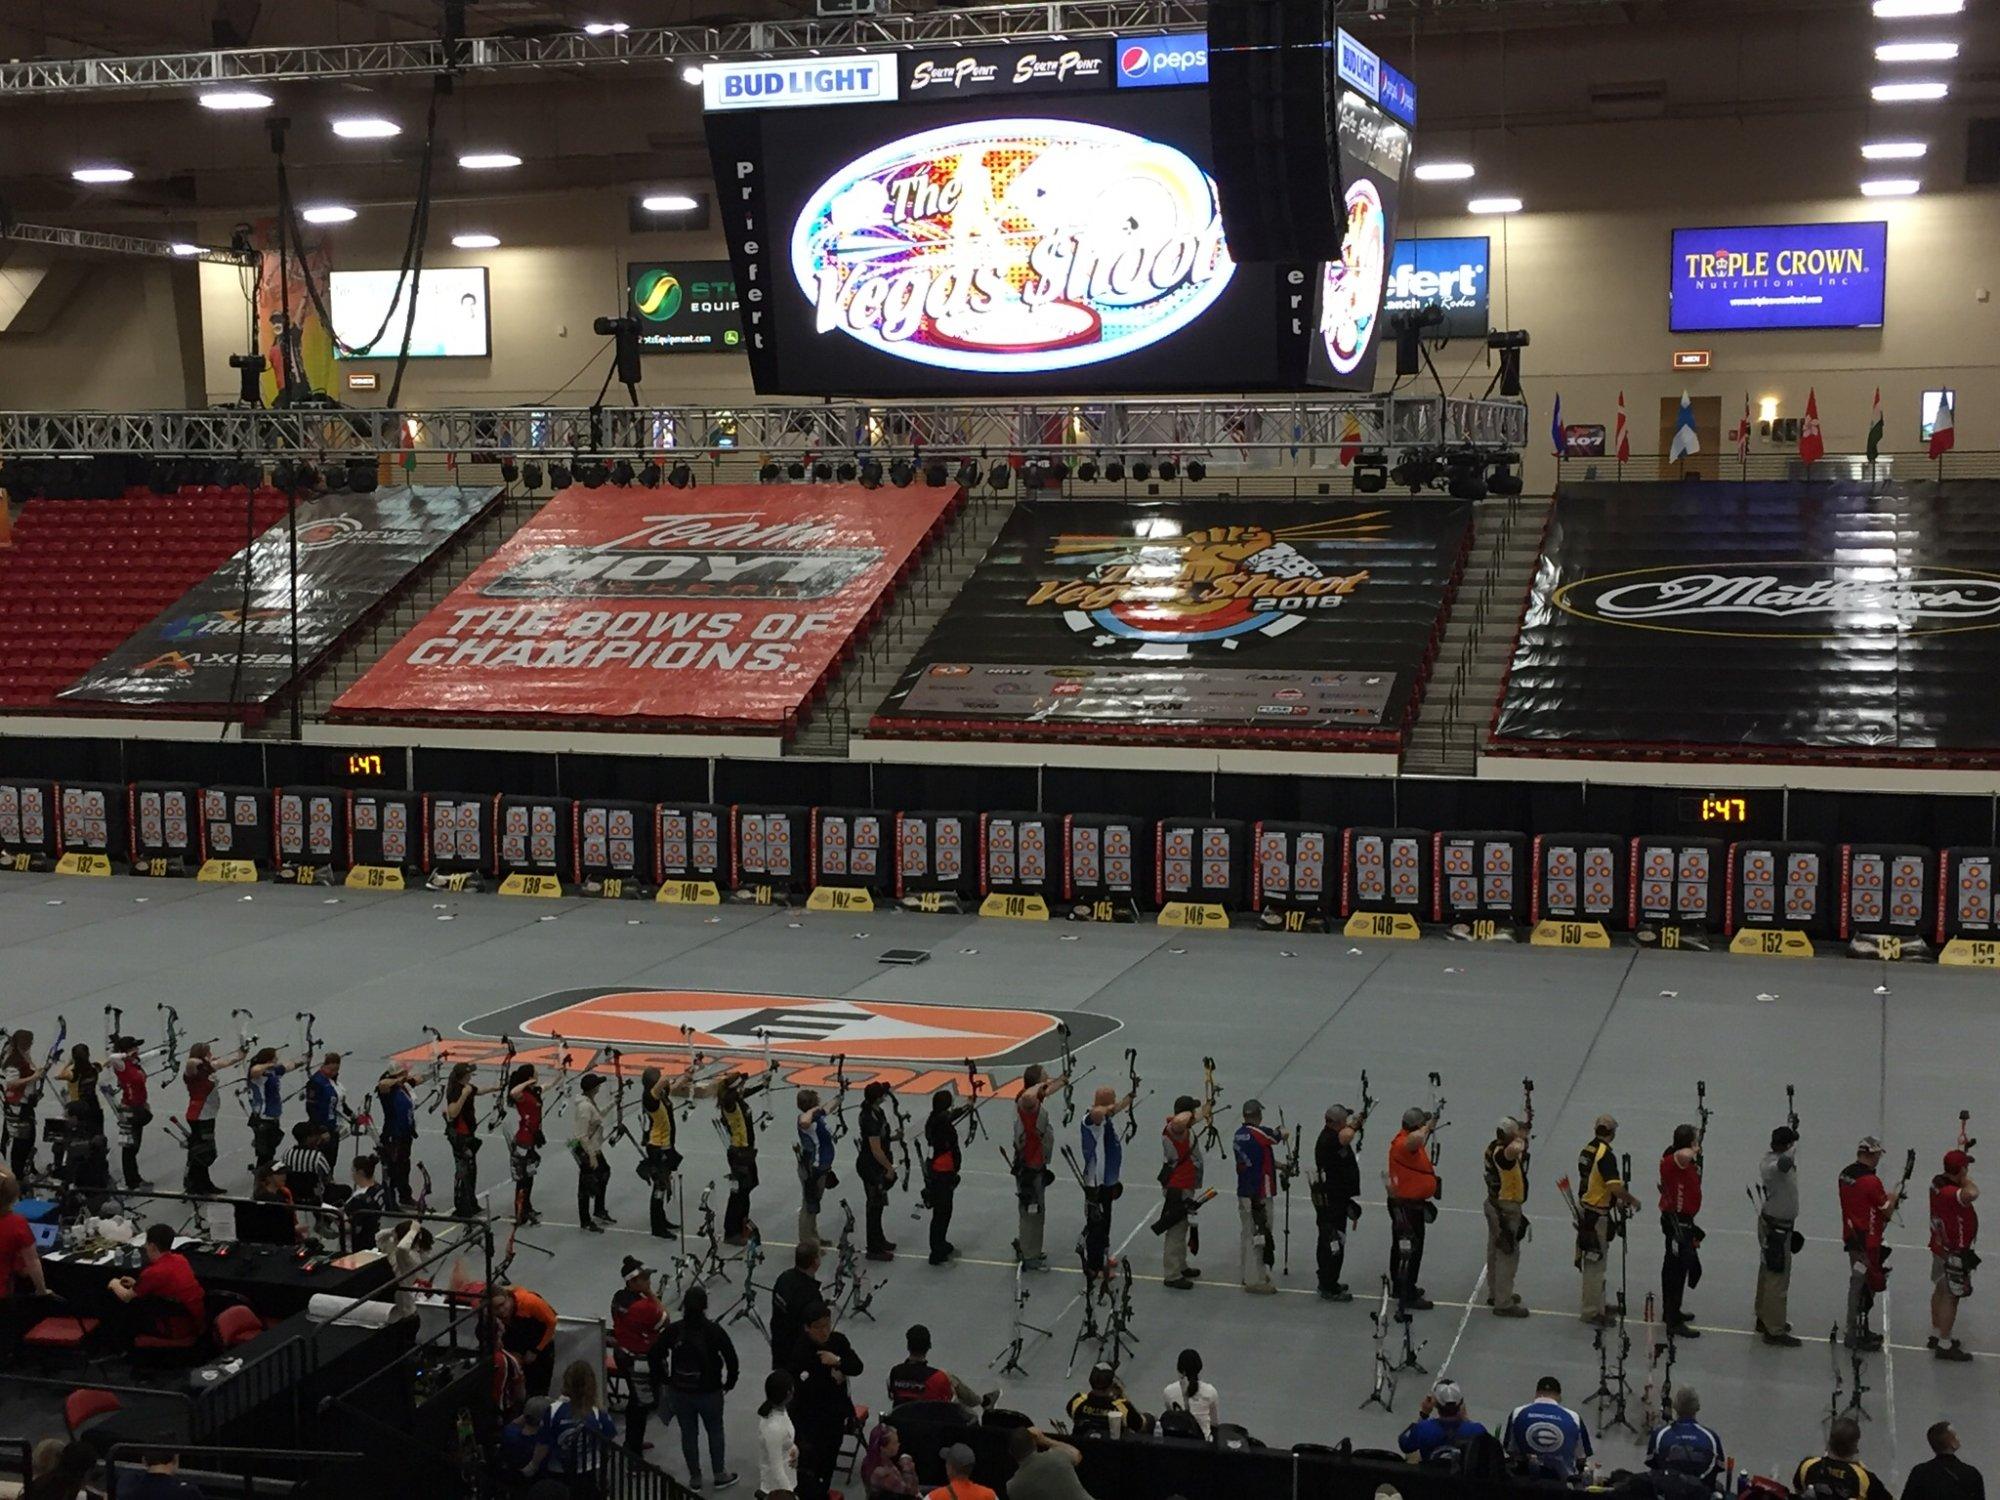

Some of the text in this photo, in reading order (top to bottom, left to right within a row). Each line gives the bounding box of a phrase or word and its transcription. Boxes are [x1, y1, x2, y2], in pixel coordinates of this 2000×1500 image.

[1153, 50, 1207, 73] peps
[724, 68, 873, 97] BUD LIGHT
[890, 166, 963, 223] The
[1776, 248, 1863, 275] CROWN
[812, 262, 1003, 342] Vegas
[1567, 437, 1603, 446] 107
[591, 512, 836, 552] Team
[508, 554, 862, 582] HOYT
[1252, 595, 1343, 612] 2018
[446, 608, 836, 640] THE BOWS OF
[406, 637, 802, 671] CHAMPIONS.
[1703, 799, 1745, 821] 1:47
[77, 856, 93, 873] 132
[297, 865, 315, 885] 135
[368, 868, 385, 886] 136
[523, 875, 540, 893] 138
[603, 879, 622, 898] 139
[680, 883, 699, 901] 140
[832, 890, 851, 909] 142
[1005, 897, 1024, 916] 144
[1093, 901, 1113, 921] 145
[1184, 905, 1204, 925] 146
[1285, 910, 1305, 931] 147
[1372, 915, 1393, 935] 148
[1473, 919, 1495, 940] 149
[1561, 924, 1581, 944] 150
[1661, 927, 1681, 948] 151
[1761, 932, 1783, 953] 152
